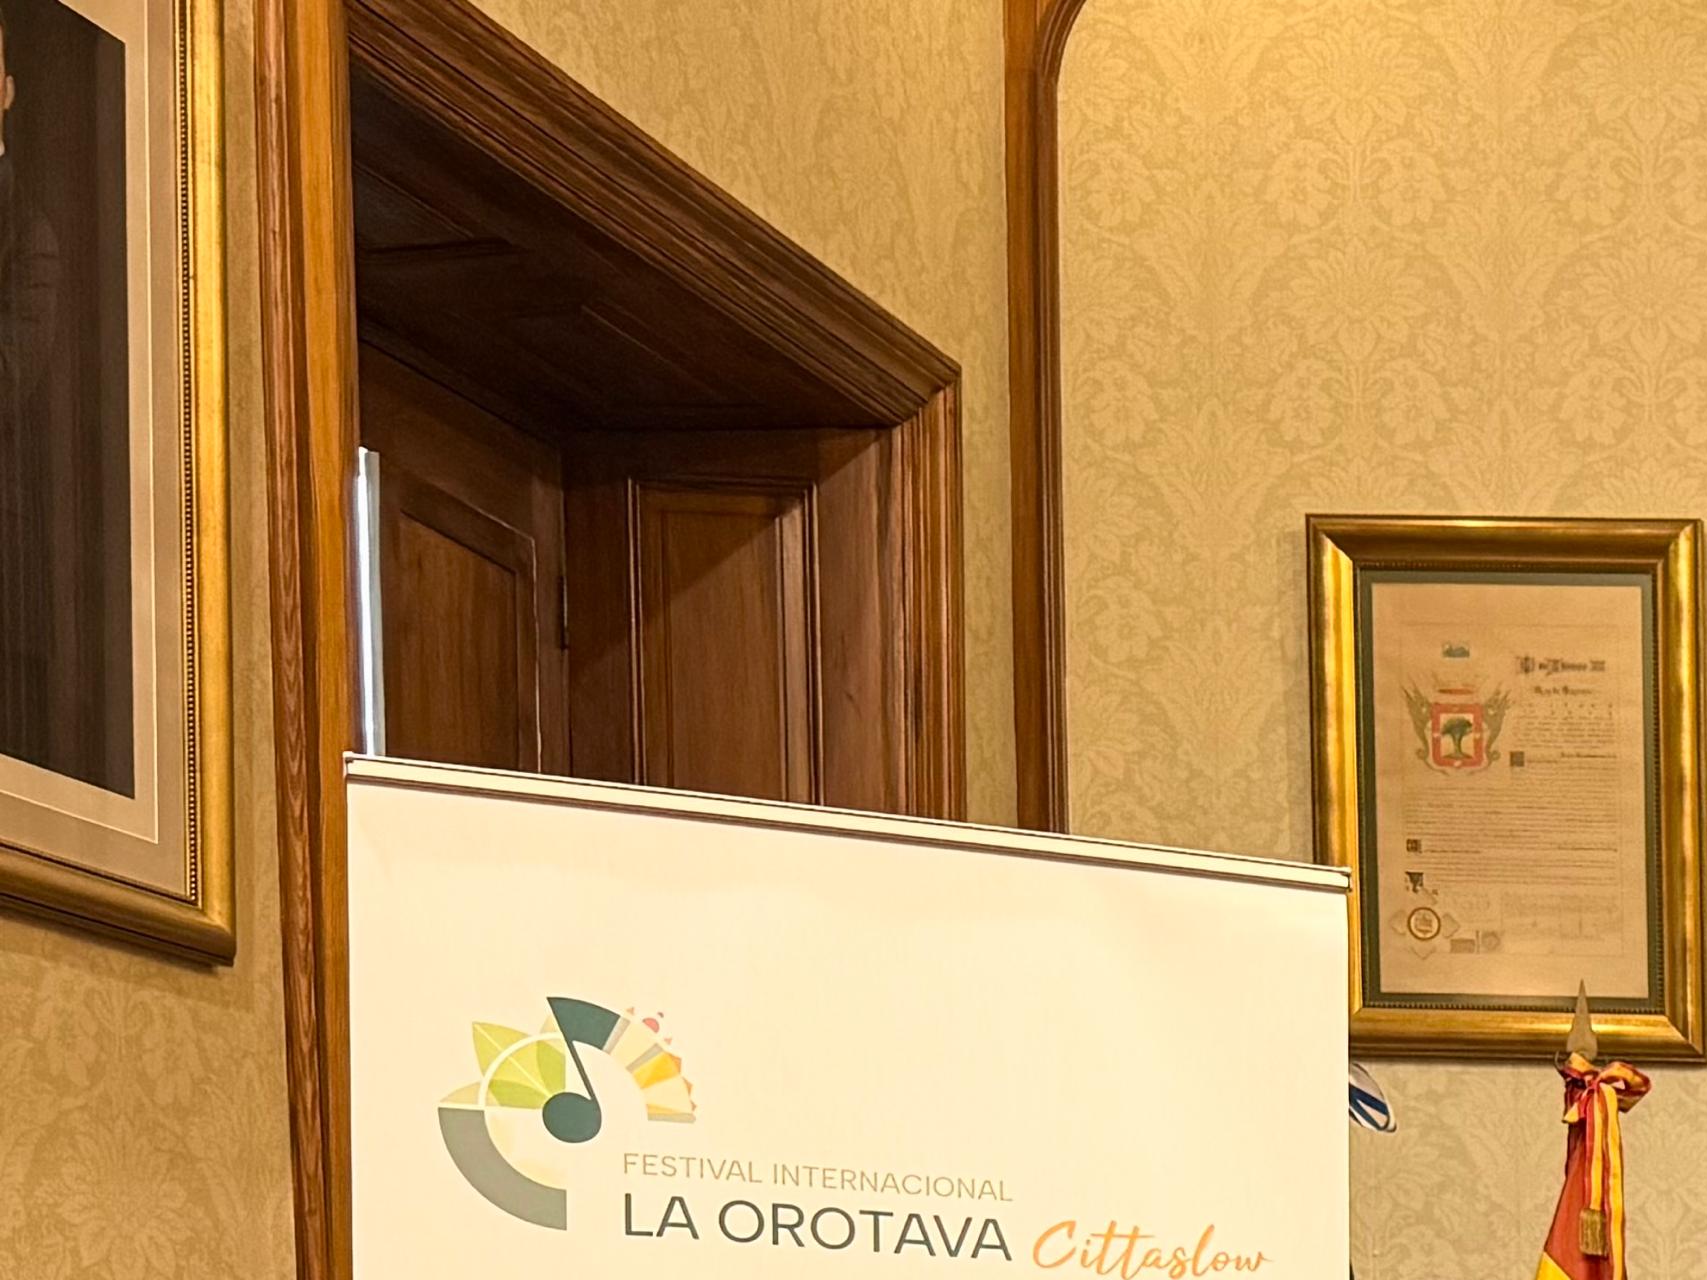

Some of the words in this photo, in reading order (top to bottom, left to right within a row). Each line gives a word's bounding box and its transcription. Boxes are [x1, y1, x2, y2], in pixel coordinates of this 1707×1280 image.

[623, 1152, 763, 1184] FESTIVAL
[773, 1163, 1013, 1202] INTERNACIONAL
[624, 1192, 700, 1240] LA
[718, 1199, 1012, 1262] OROTAVA
[1032, 1219, 1274, 1280] Cittaslow
